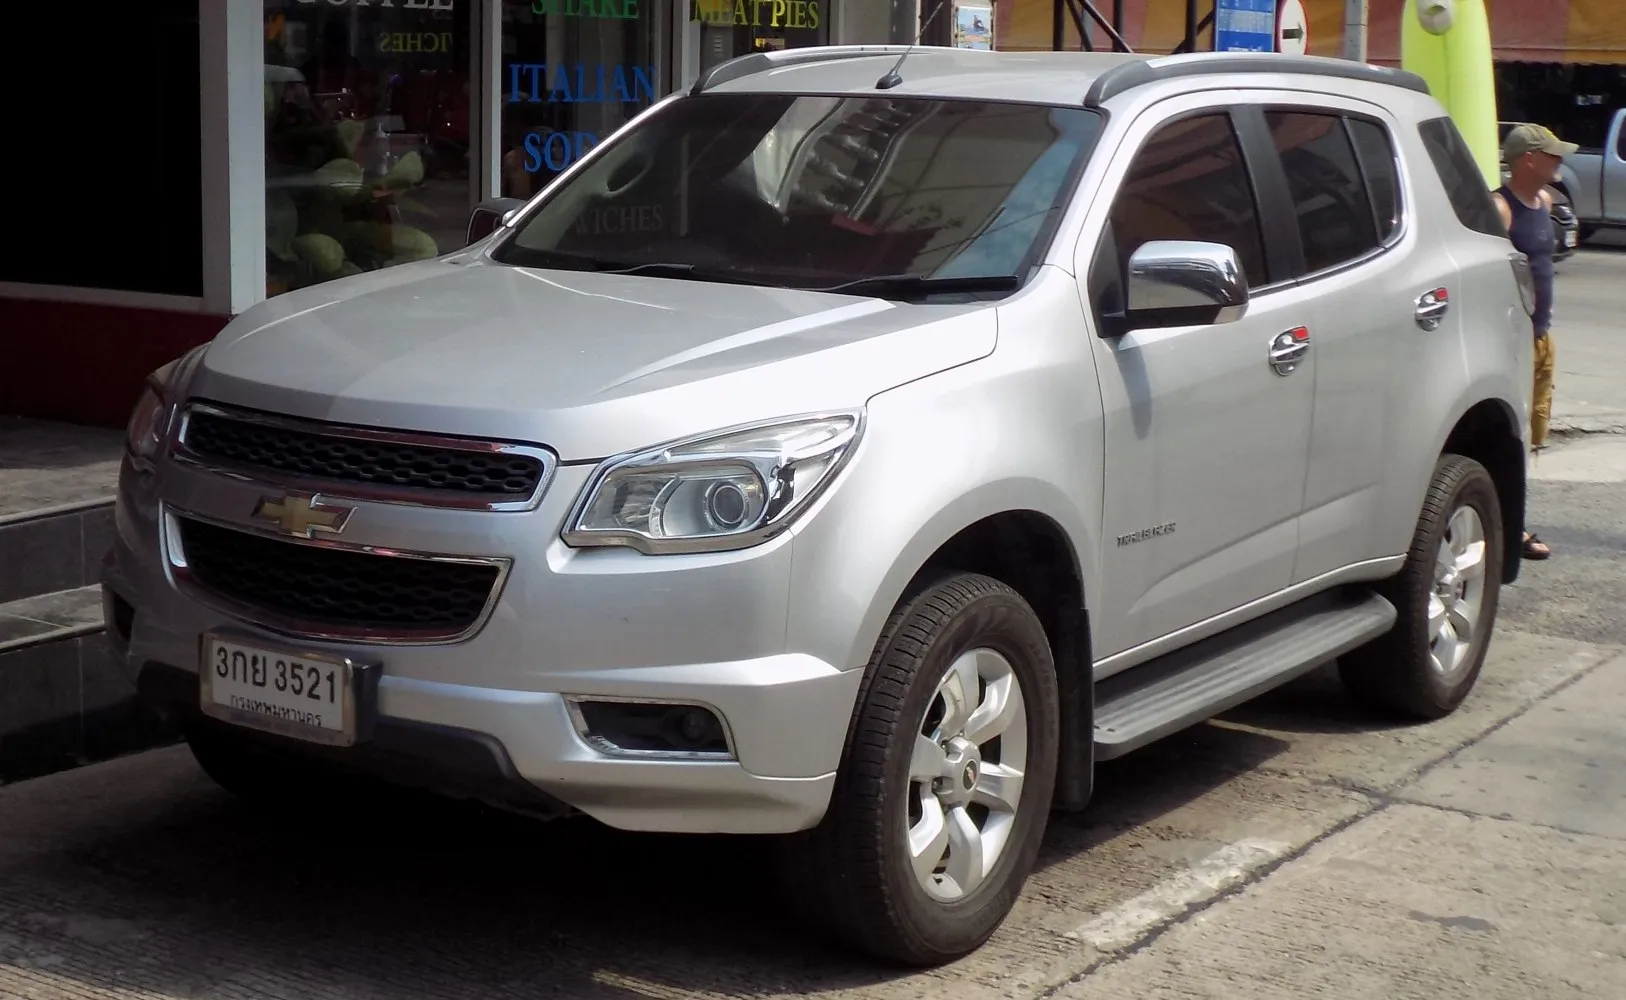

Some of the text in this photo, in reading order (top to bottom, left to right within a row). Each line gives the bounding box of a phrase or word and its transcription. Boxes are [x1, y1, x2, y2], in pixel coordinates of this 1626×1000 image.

[770, 0, 819, 29] PIES
[509, 63, 656, 103] ITALIAN
[216, 646, 336, 704] 3กย 3521
